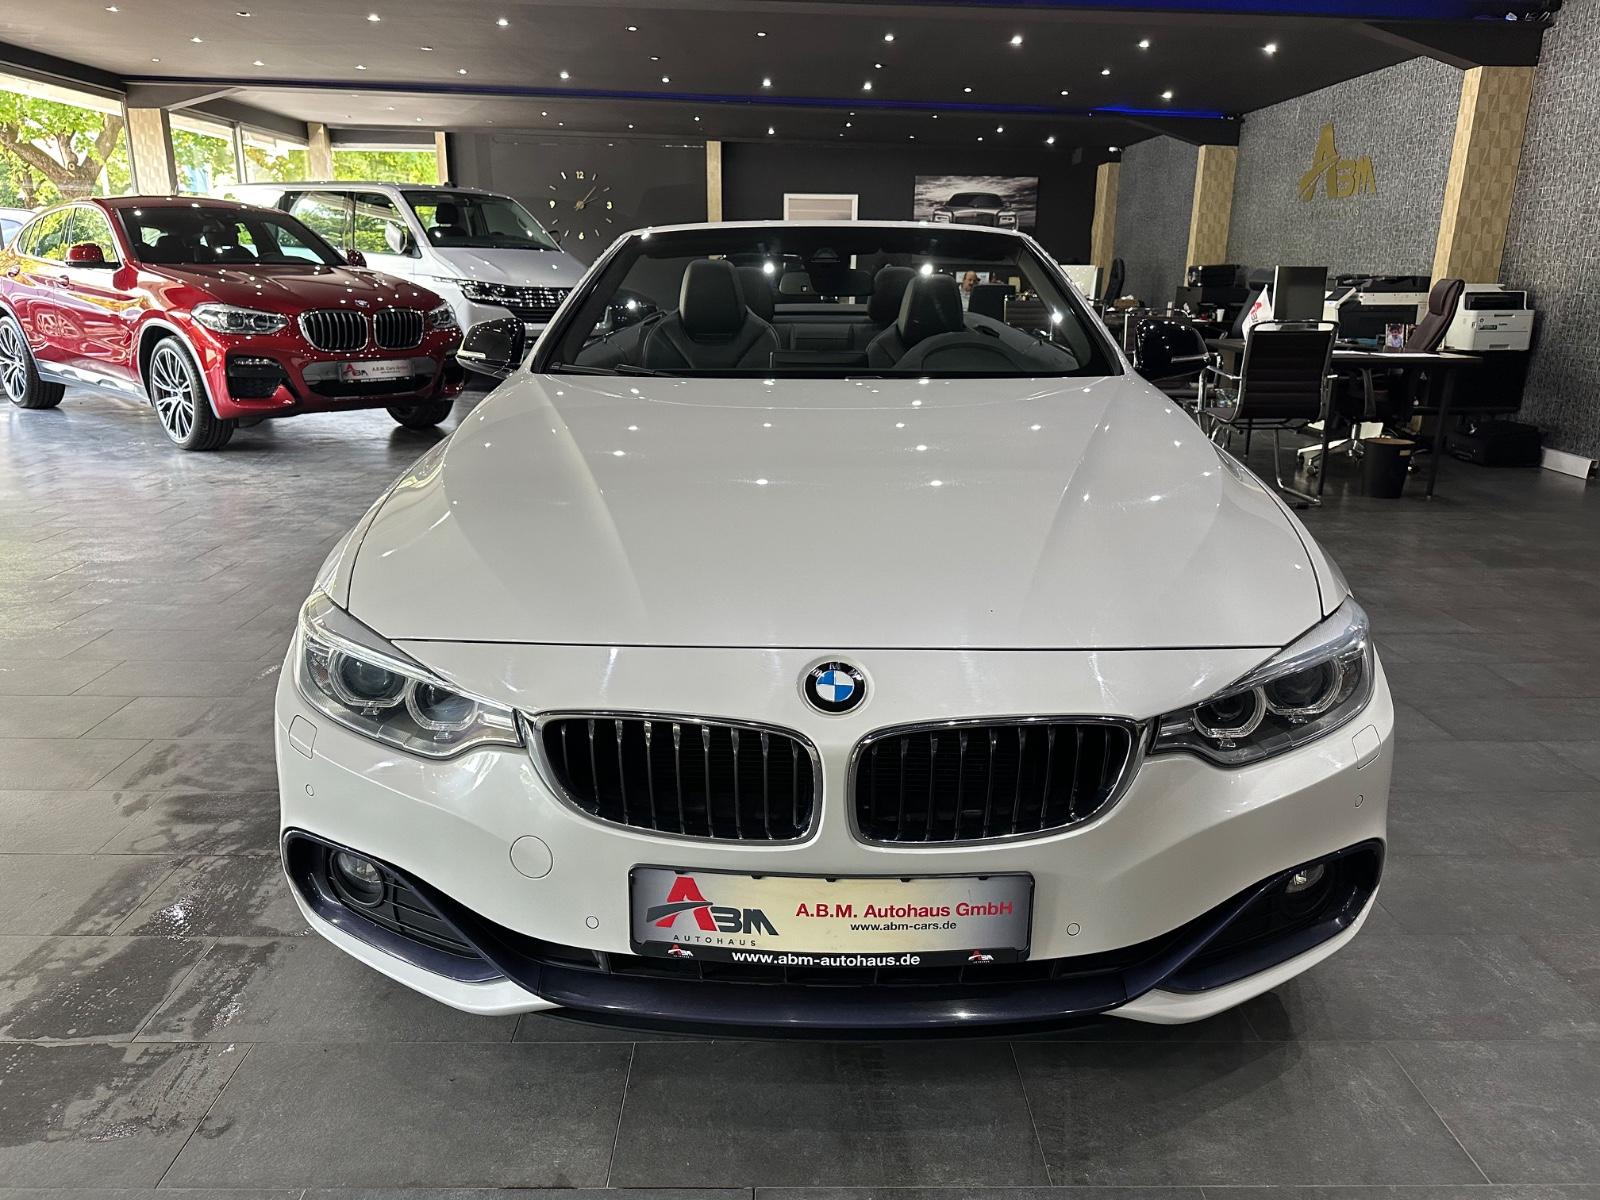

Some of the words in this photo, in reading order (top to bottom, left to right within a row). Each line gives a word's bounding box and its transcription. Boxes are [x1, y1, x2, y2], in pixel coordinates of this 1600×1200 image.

[1296, 121, 1377, 202] ABM
[575, 170, 585, 179] 12
[549, 200, 556, 209] 9
[606, 201, 613, 210] 3
[578, 232, 585, 240] 6
[646, 876, 780, 936] ABM
[795, 903, 858, 918] A.B.M.
[863, 904, 951, 918] Autohaus
[955, 902, 1014, 917] GmbH
[850, 921, 957, 931] www.abm-cars.de
[673, 934, 756, 947] AUTOHAUS
[732, 951, 921, 966] www.abm-autohaus.de
